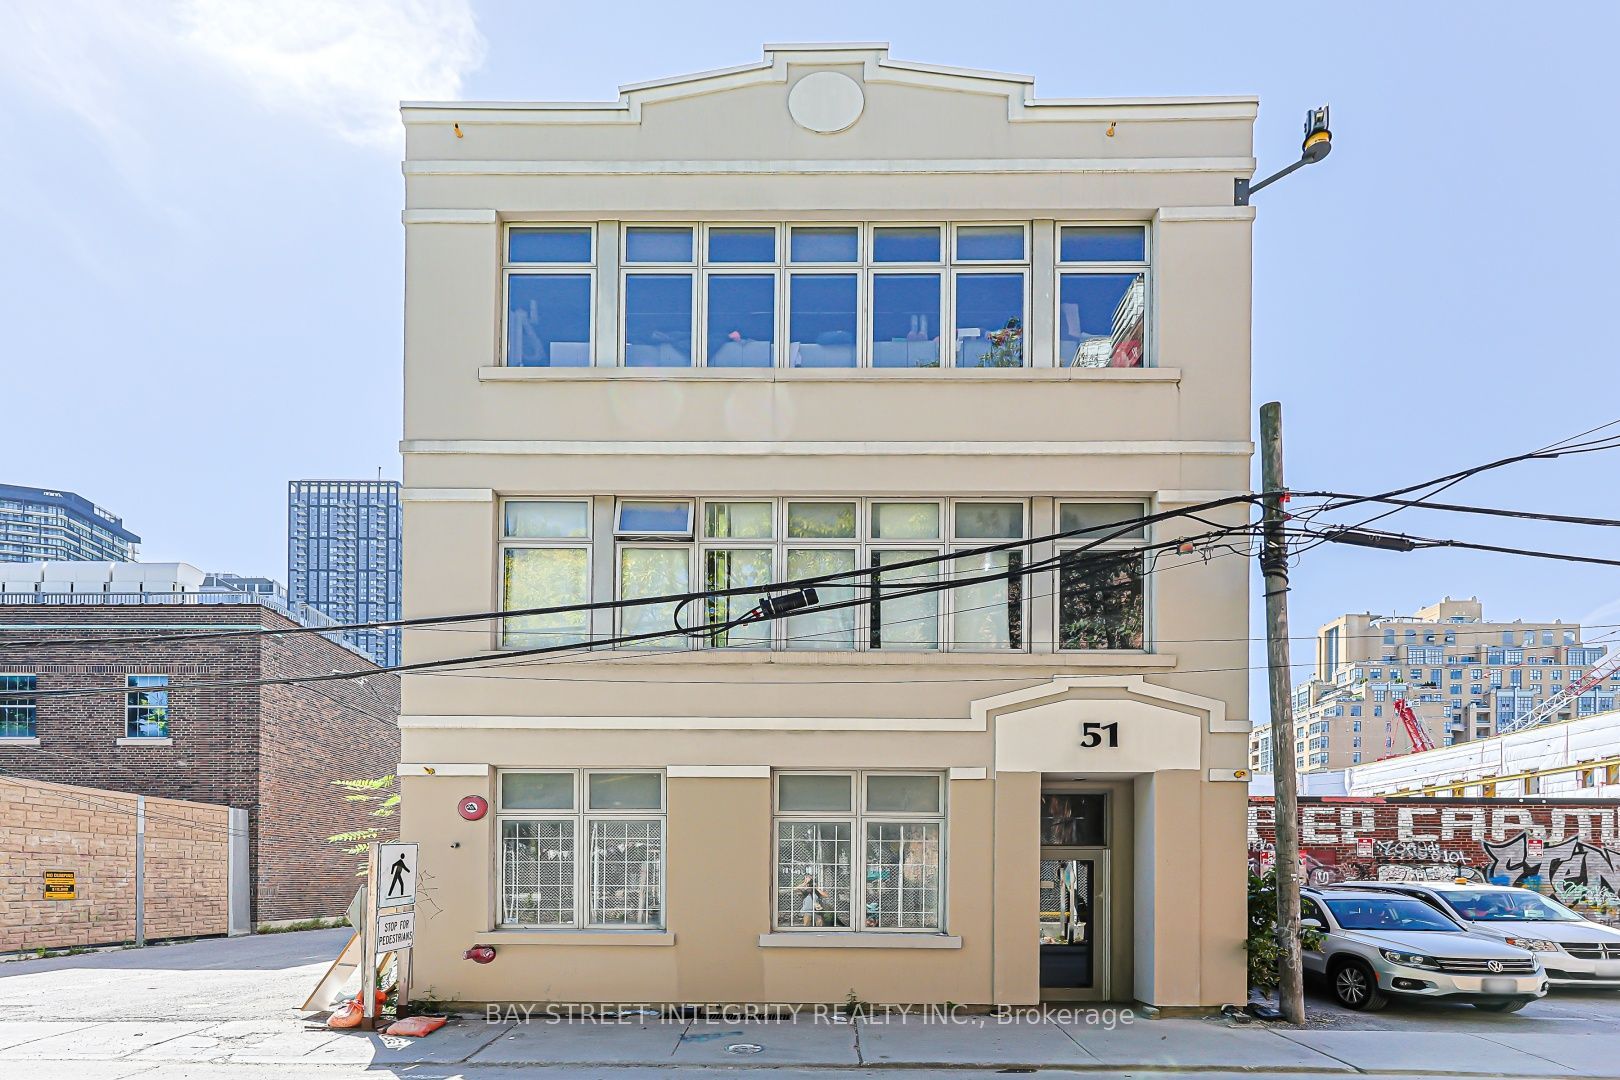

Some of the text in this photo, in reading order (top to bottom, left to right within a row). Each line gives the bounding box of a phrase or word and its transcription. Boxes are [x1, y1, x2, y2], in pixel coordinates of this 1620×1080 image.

[1081, 721, 1118, 748] 51
[385, 920, 409, 932] STOP FOR
[379, 932, 412, 946] PEDESTRIANS
